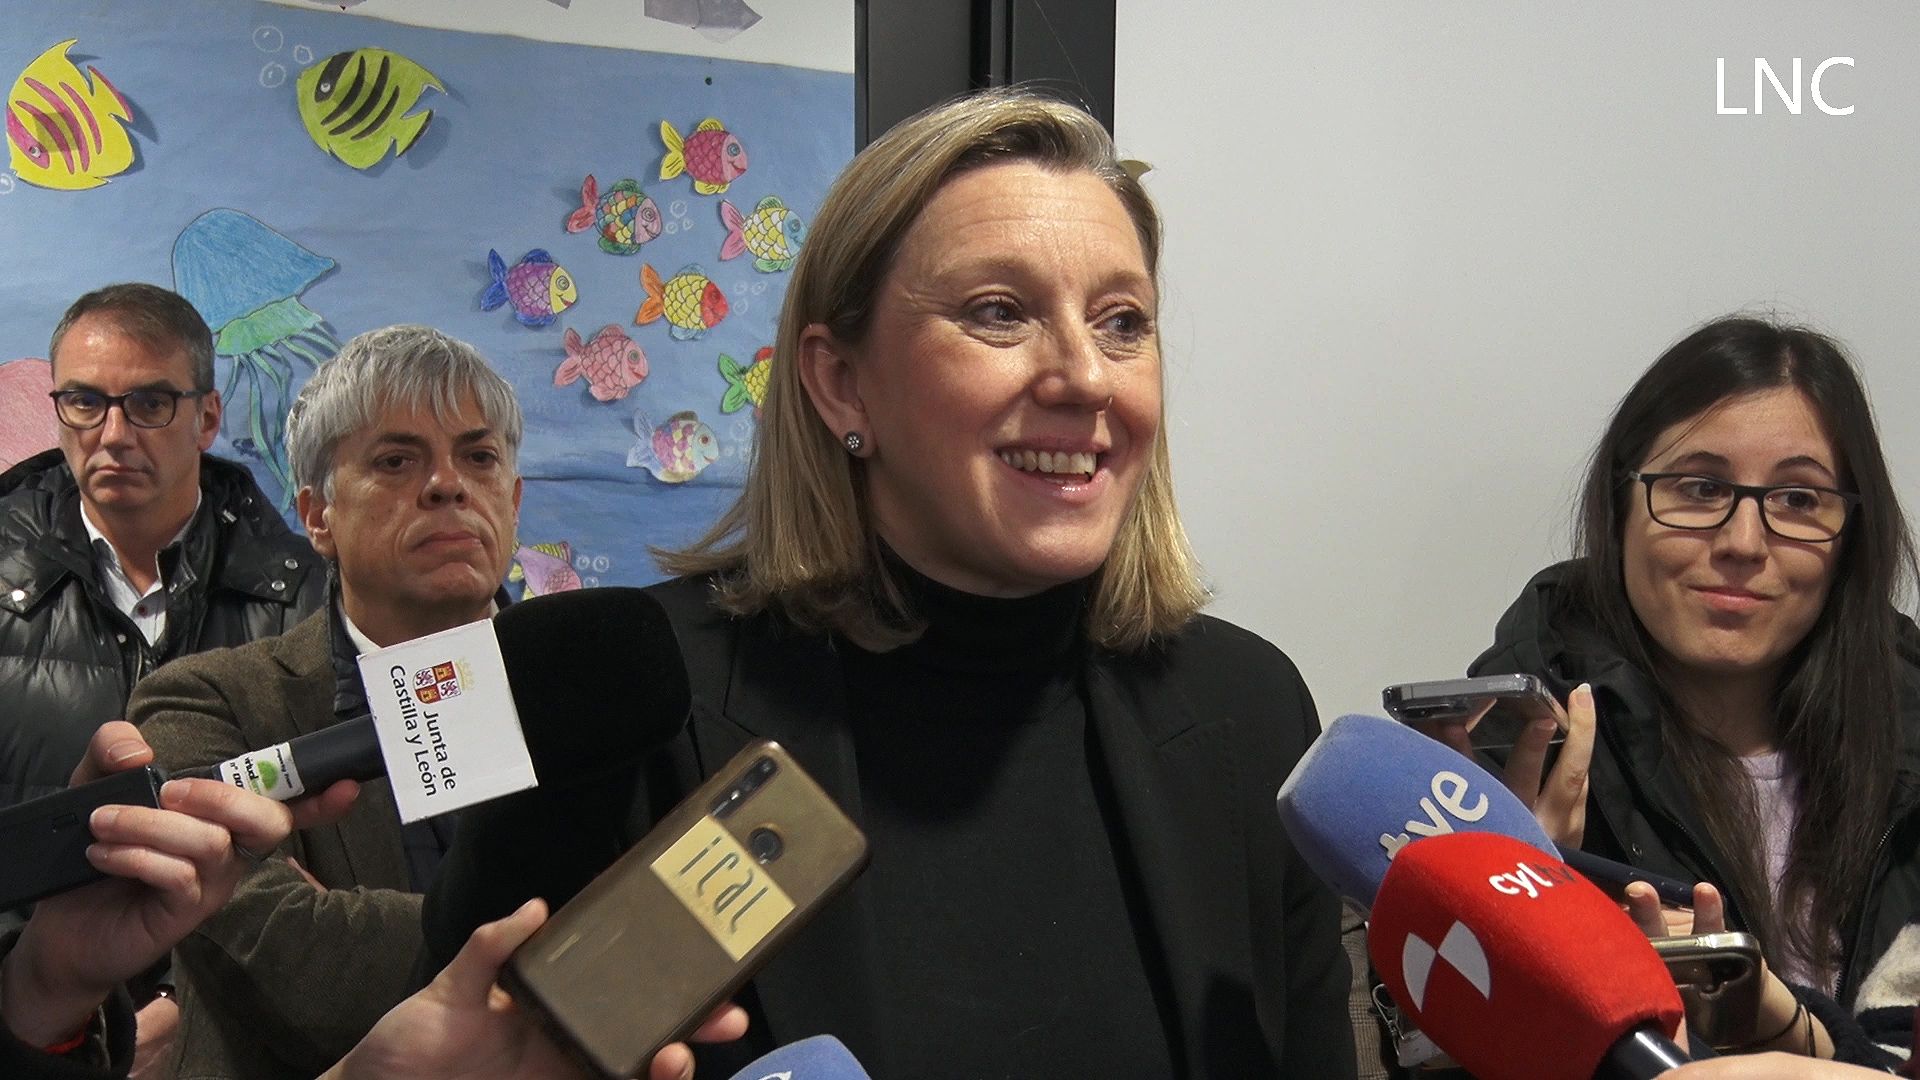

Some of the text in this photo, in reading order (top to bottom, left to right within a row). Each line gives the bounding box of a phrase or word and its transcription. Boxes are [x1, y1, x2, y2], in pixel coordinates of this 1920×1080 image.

[390, 665, 437, 796] Castilla y León
[423, 710, 456, 790] Junta de
